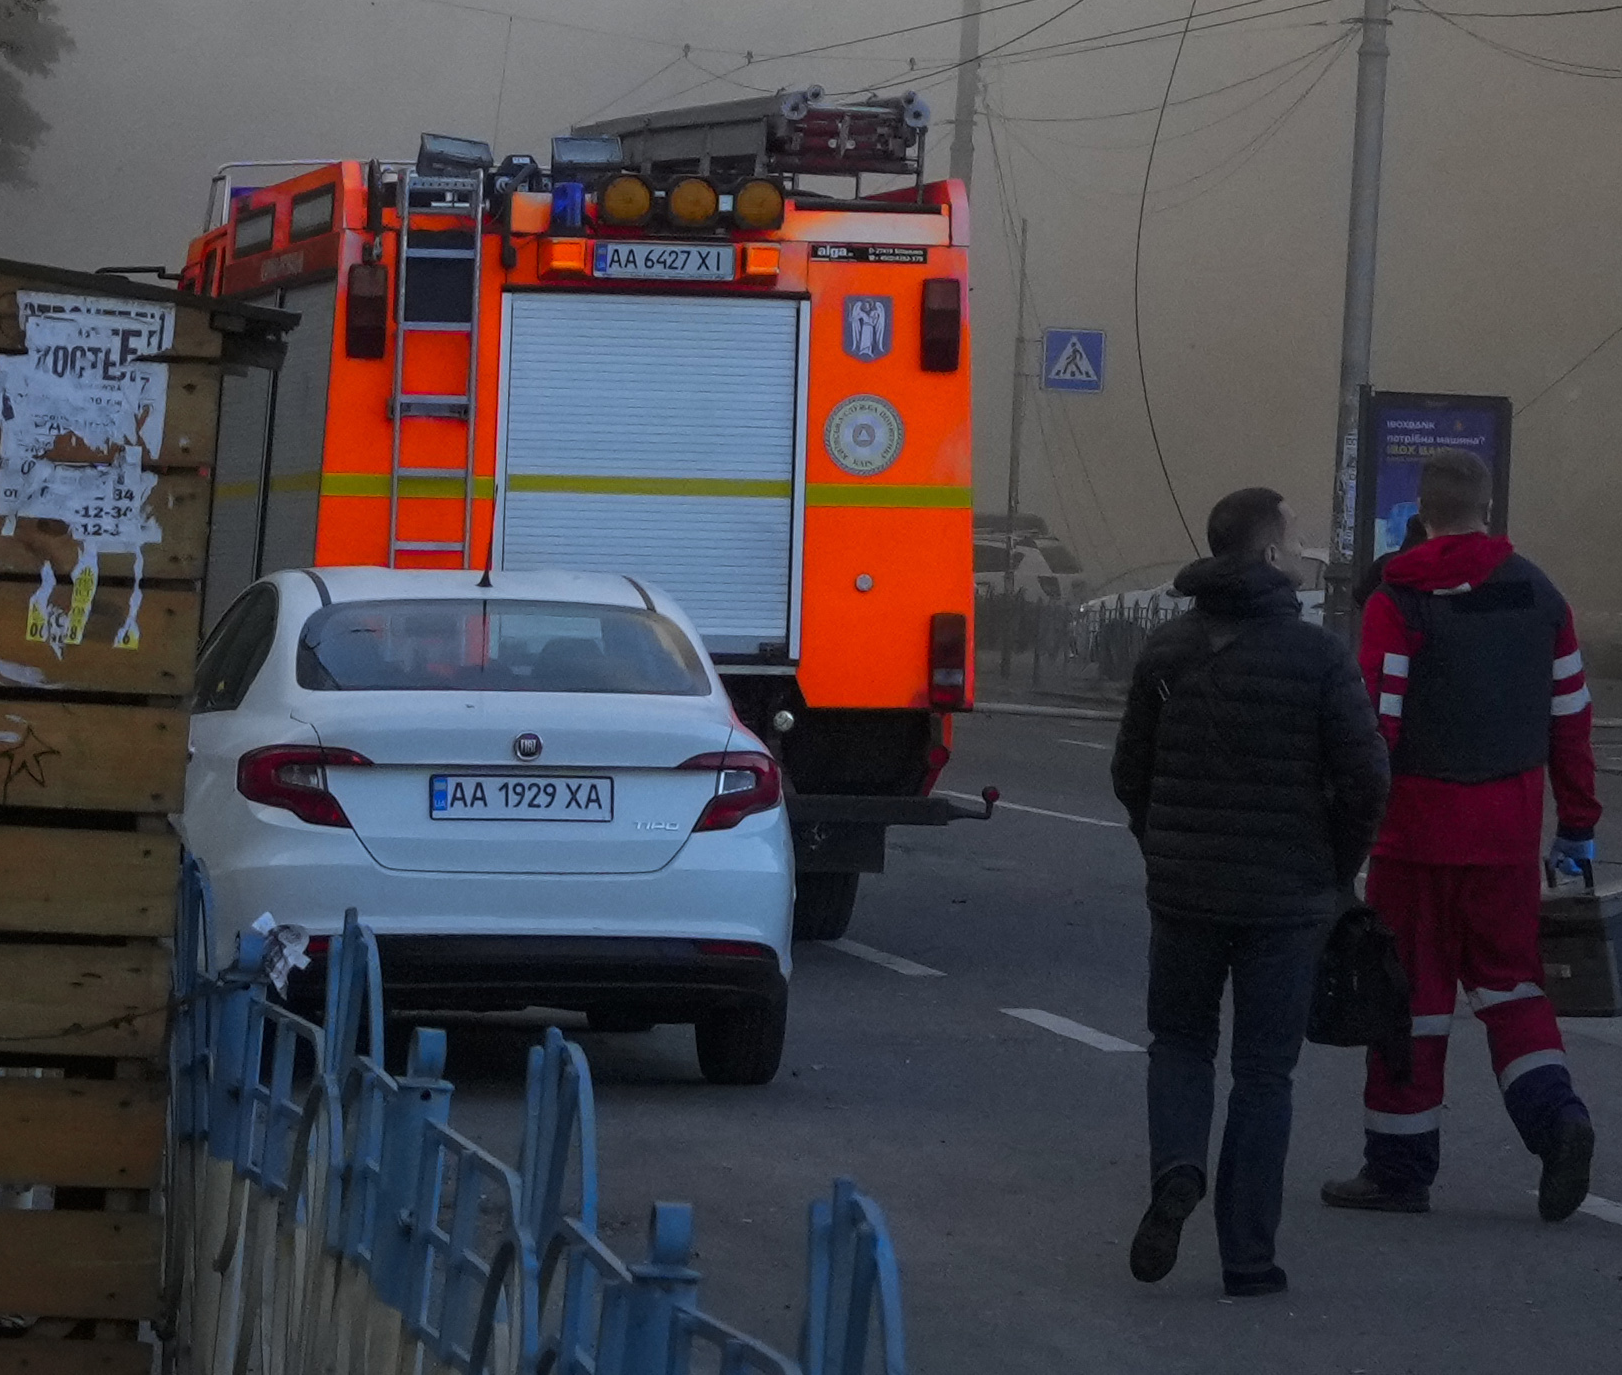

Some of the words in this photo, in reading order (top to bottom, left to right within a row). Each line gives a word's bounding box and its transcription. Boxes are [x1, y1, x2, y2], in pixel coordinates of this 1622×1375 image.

[608, 248, 638, 269] AA
[644, 249, 691, 270] 6427
[817, 245, 848, 258] alga
[450, 782, 488, 809] AA
[498, 782, 557, 809] 1929
[565, 783, 603, 811] XA
[634, 820, 679, 831] TIPO
